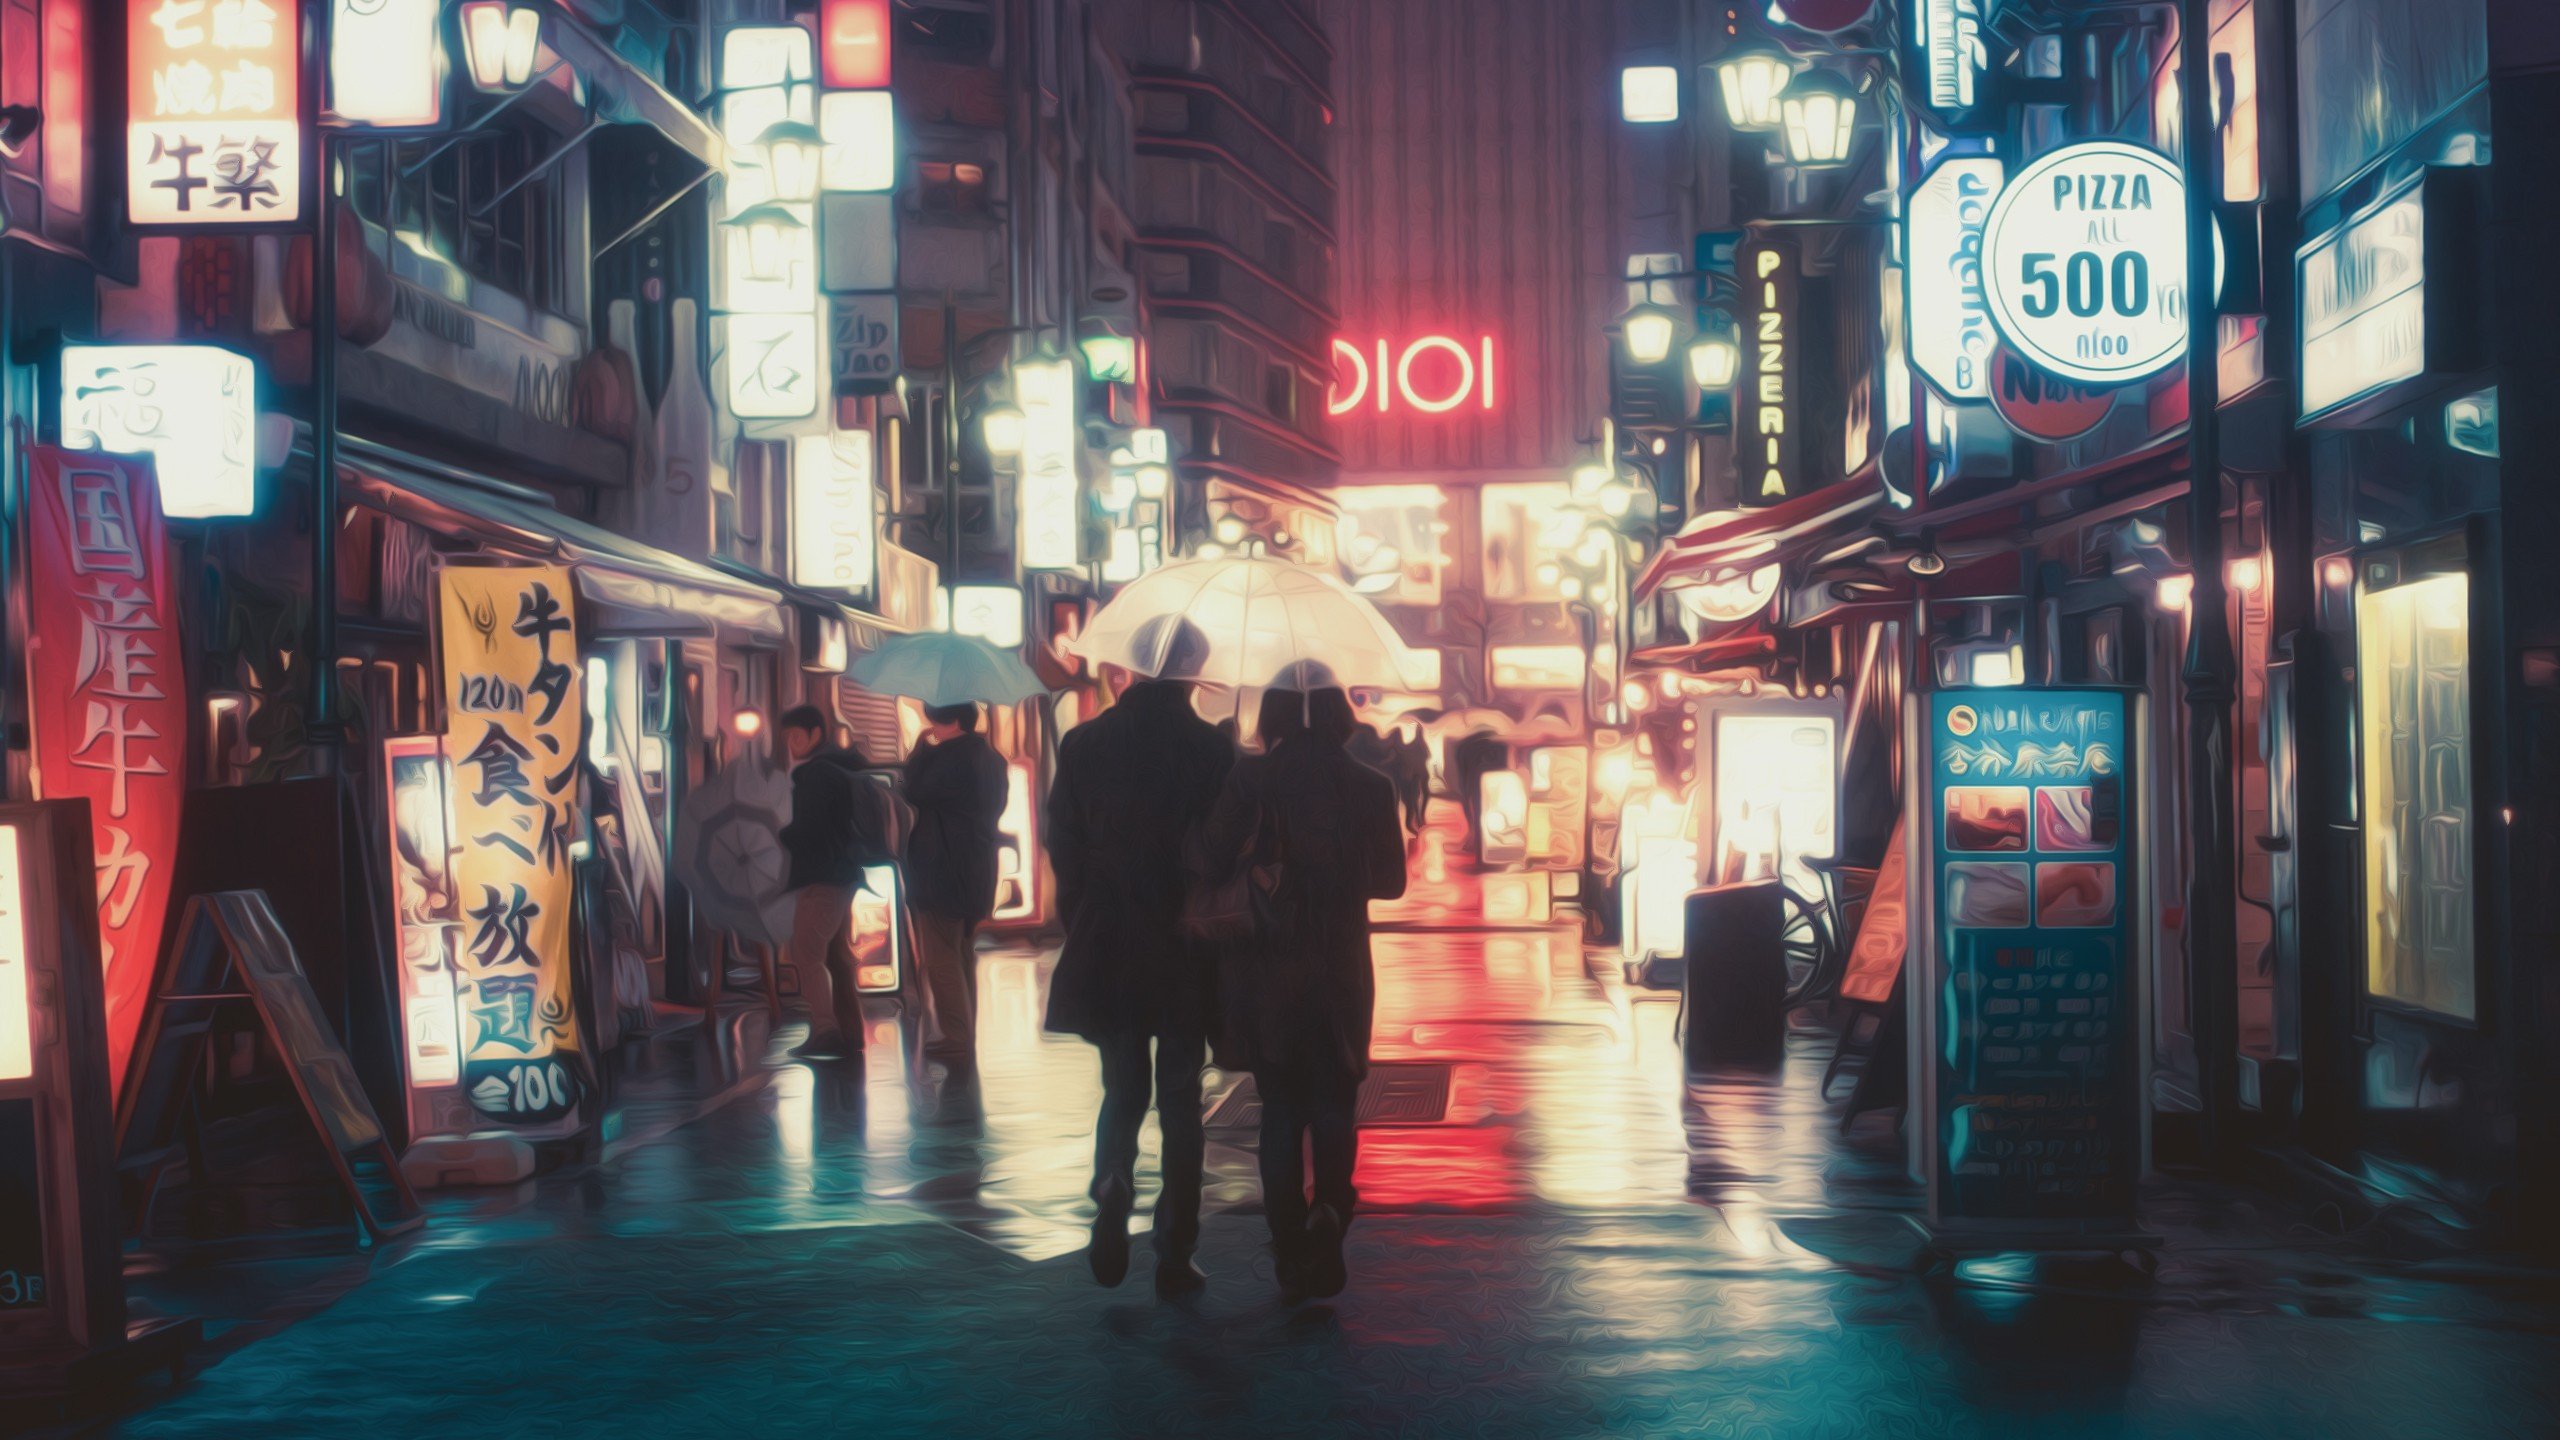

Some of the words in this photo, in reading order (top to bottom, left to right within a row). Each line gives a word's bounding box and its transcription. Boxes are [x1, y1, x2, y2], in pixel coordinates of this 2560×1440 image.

[147, 132, 286, 211] 牛繁
[2053, 174, 2152, 211] PIZZA
[2022, 250, 2148, 318] 500
[1757, 250, 1787, 496] PIZZERIA
[60, 462, 169, 975] 国産牛カ
